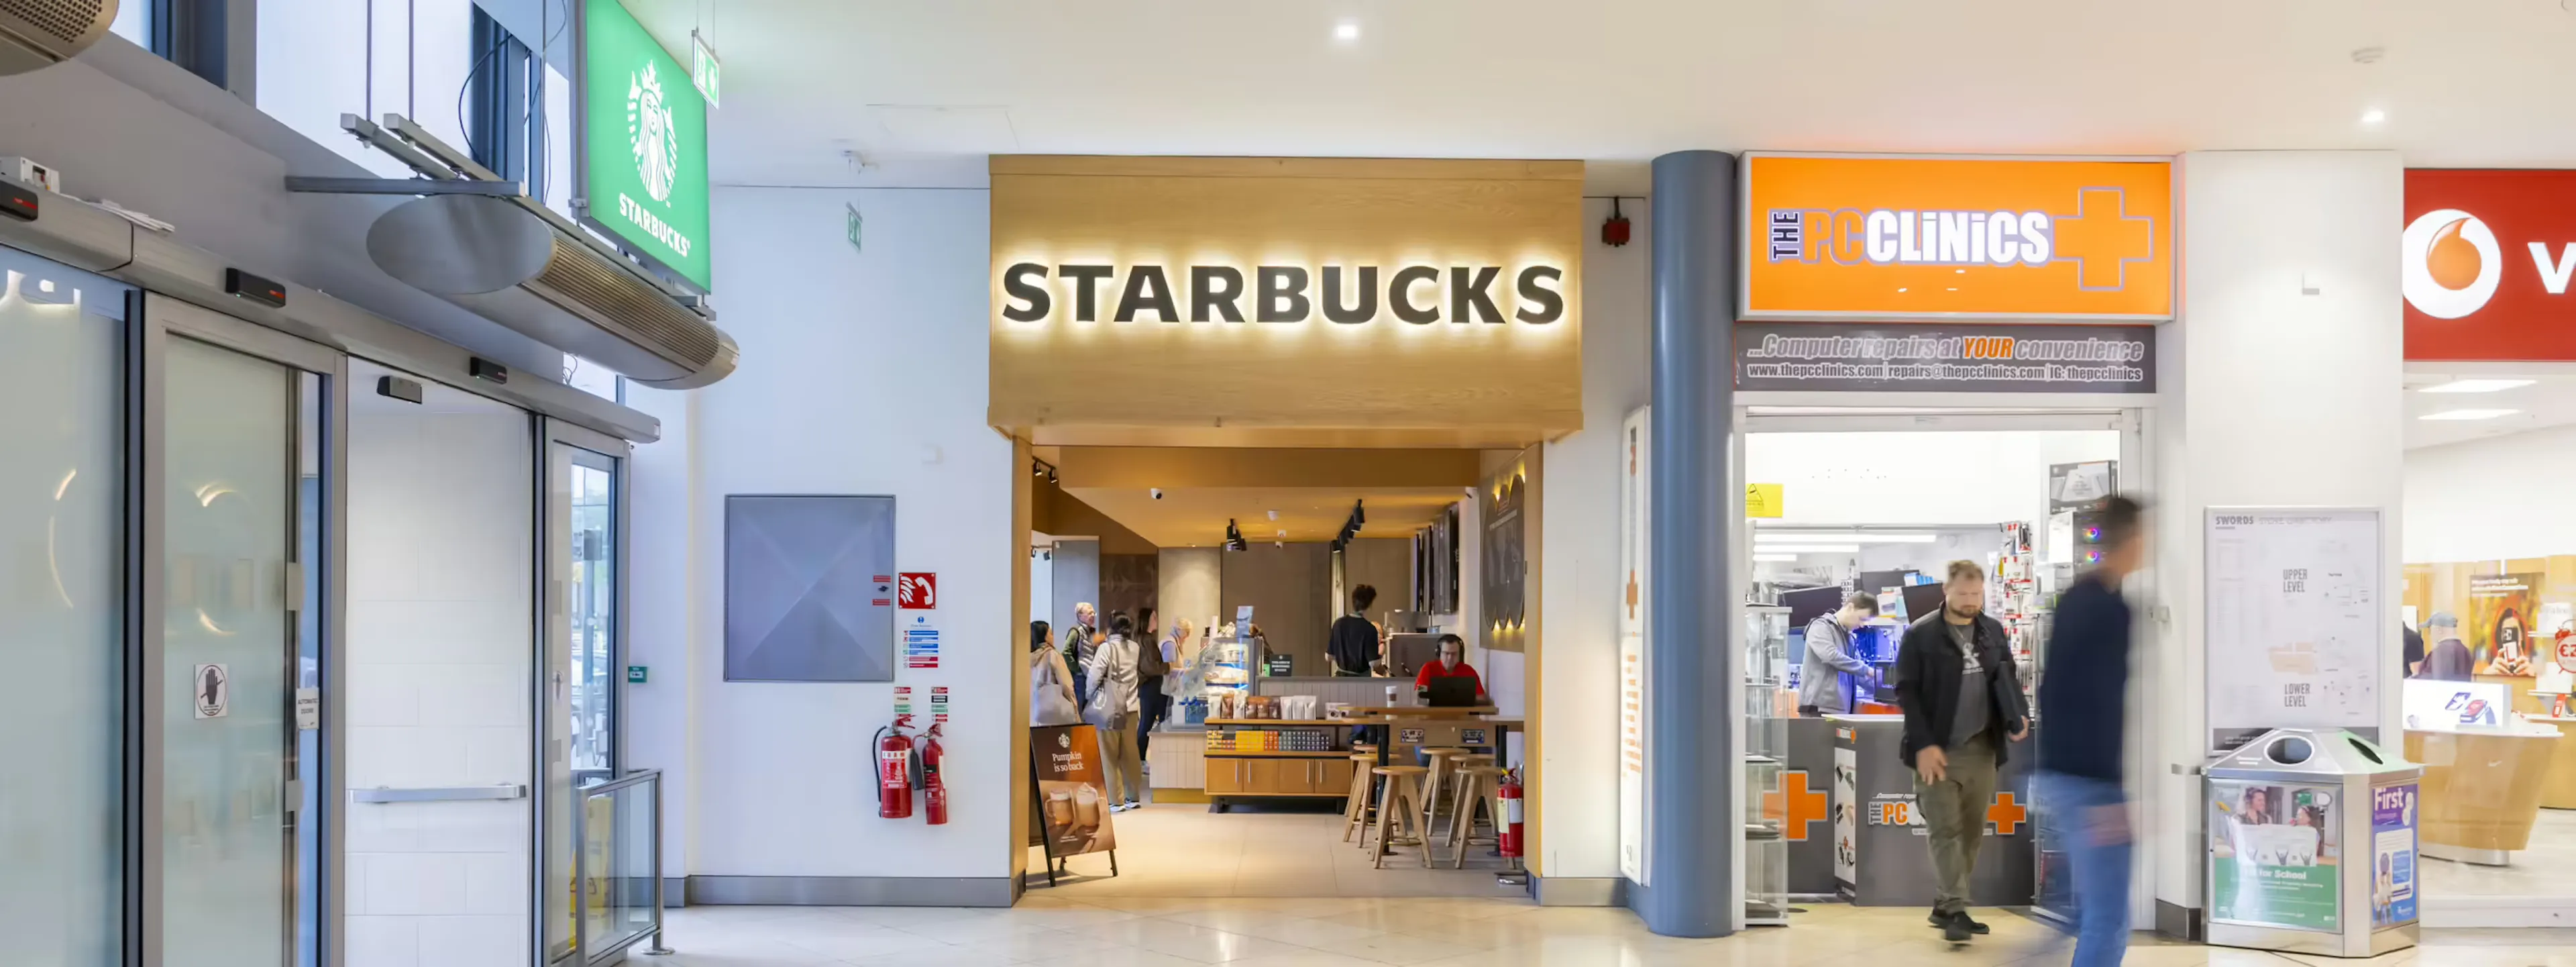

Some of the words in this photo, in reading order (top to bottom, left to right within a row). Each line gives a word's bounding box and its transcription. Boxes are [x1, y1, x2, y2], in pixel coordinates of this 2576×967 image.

[619, 192, 688, 258] STARBUCKS
[1772, 211, 1800, 261] THE
[1002, 262, 1564, 326] STARBUCKS
[1861, 336, 1937, 360] repairs
[1937, 337, 1960, 359] at
[1963, 336, 2014, 359] YOUR
[2015, 338, 2145, 361] convenience
[1747, 362, 1883, 378] www.thepcclinics.com
[2066, 365, 2143, 381] thepcclinics
[2215, 515, 2254, 525] SWORDS
[2283, 568, 2308, 580] UPPER
[2283, 580, 2306, 593] LEVEL
[2284, 683, 2311, 695] LOWER
[2284, 695, 2307, 707] LEVEL
[1051, 751, 1082, 762] Pumpkin
[1053, 763, 1060, 772] is
[2374, 787, 2404, 811] First
[1869, 803, 1881, 823] THE
[1882, 803, 1908, 824] PC
[2274, 870, 2307, 880] School
